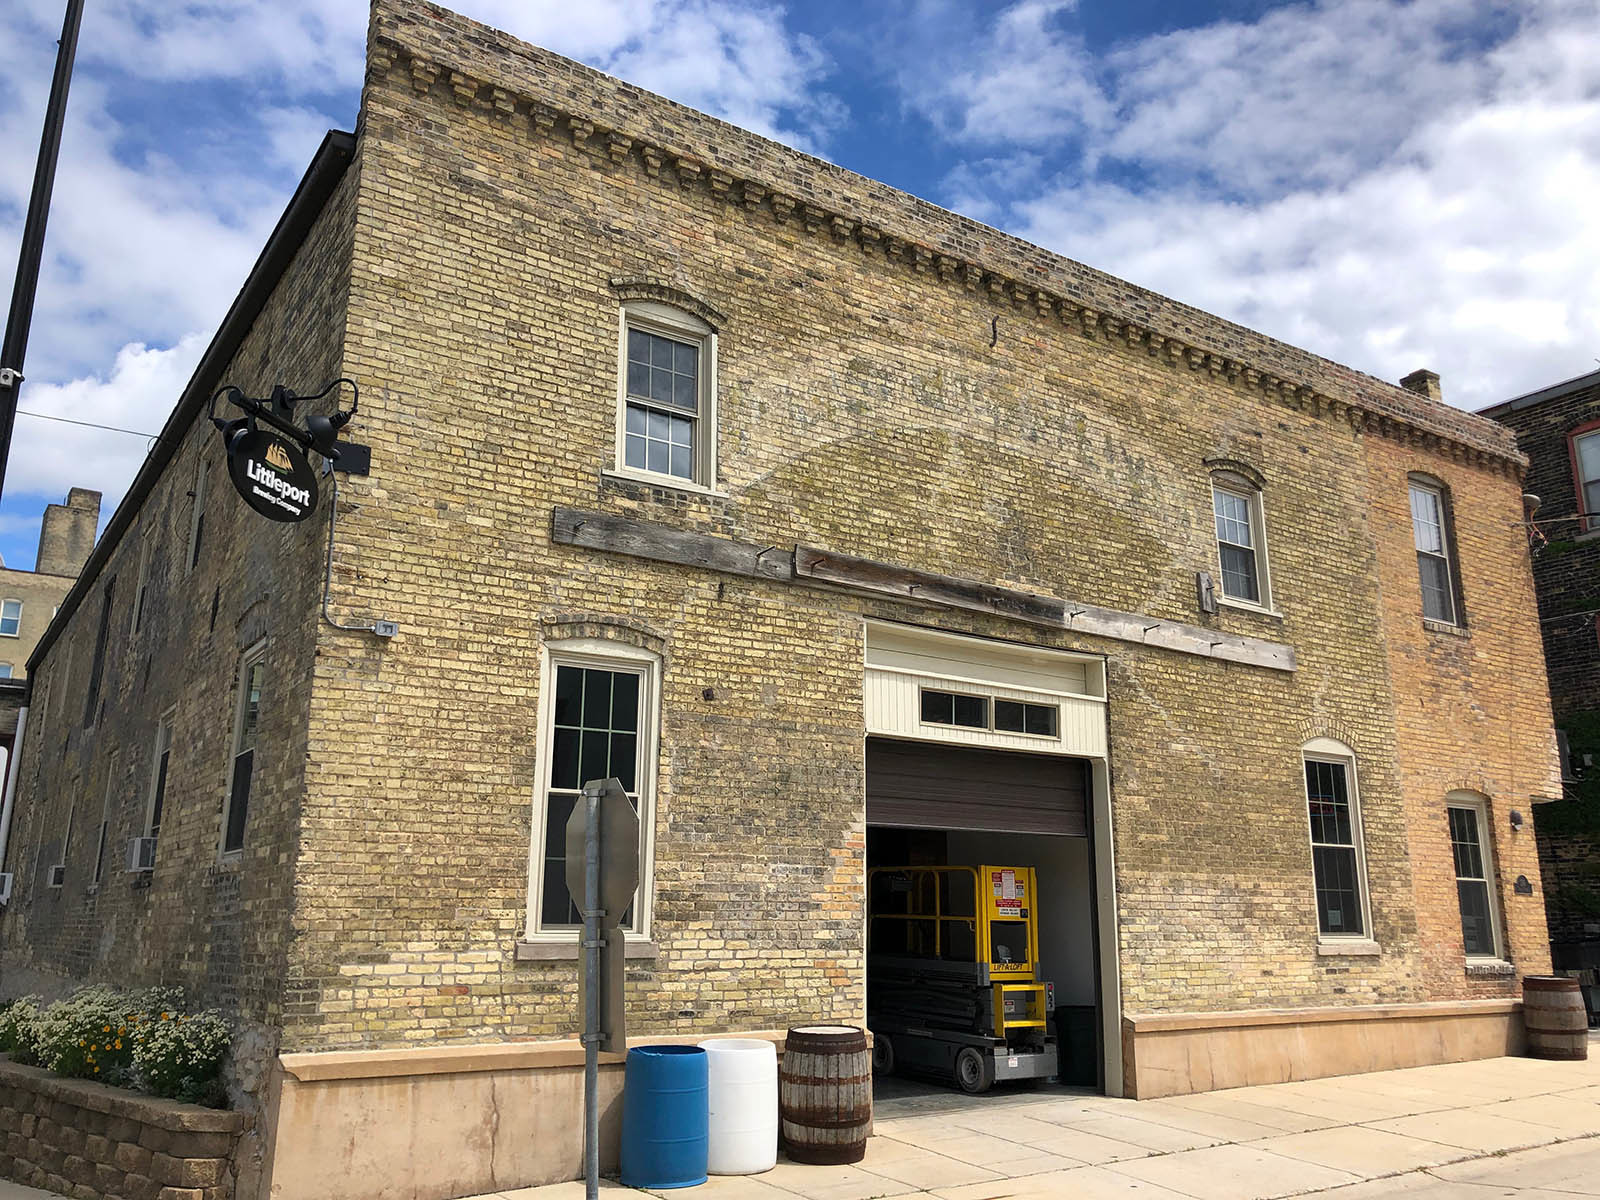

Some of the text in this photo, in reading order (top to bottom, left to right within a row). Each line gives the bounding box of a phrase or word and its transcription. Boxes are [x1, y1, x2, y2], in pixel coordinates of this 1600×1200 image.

[246, 459, 310, 506] Littleport
[252, 485, 301, 516] Brewing Company
